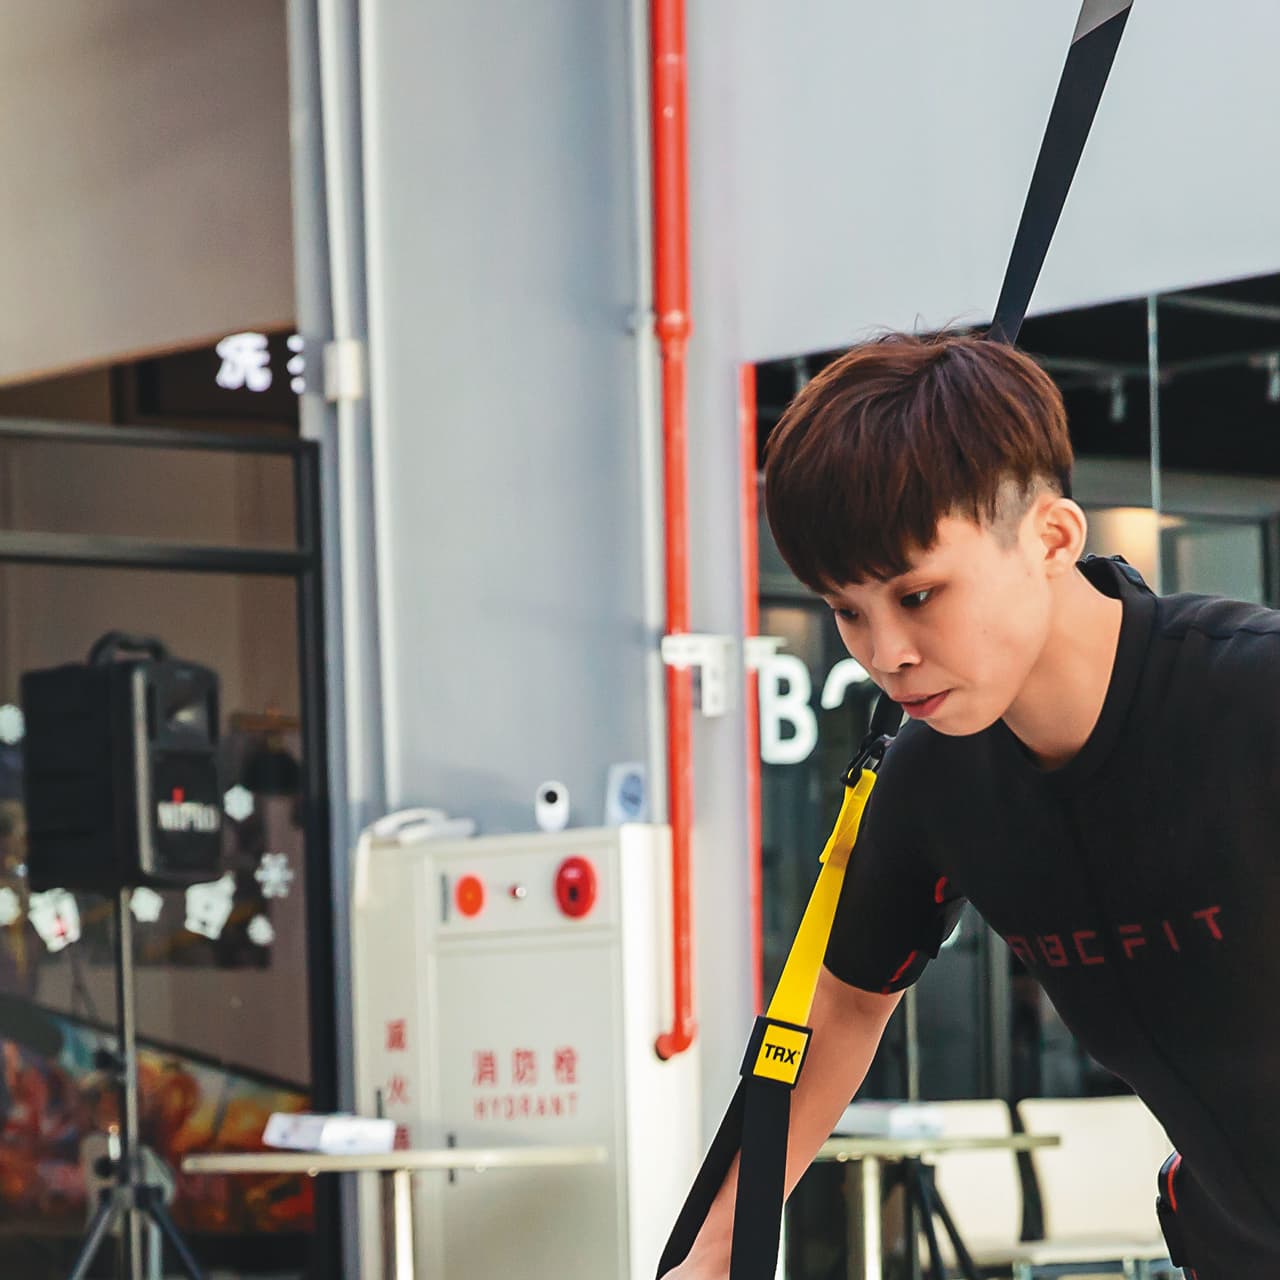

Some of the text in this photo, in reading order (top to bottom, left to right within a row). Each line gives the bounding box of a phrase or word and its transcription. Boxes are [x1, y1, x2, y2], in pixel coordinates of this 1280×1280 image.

[472, 1045, 579, 1087] 消防栓
[764, 1042, 797, 1065] TRX
[472, 1090, 579, 1121] HYDRANT
